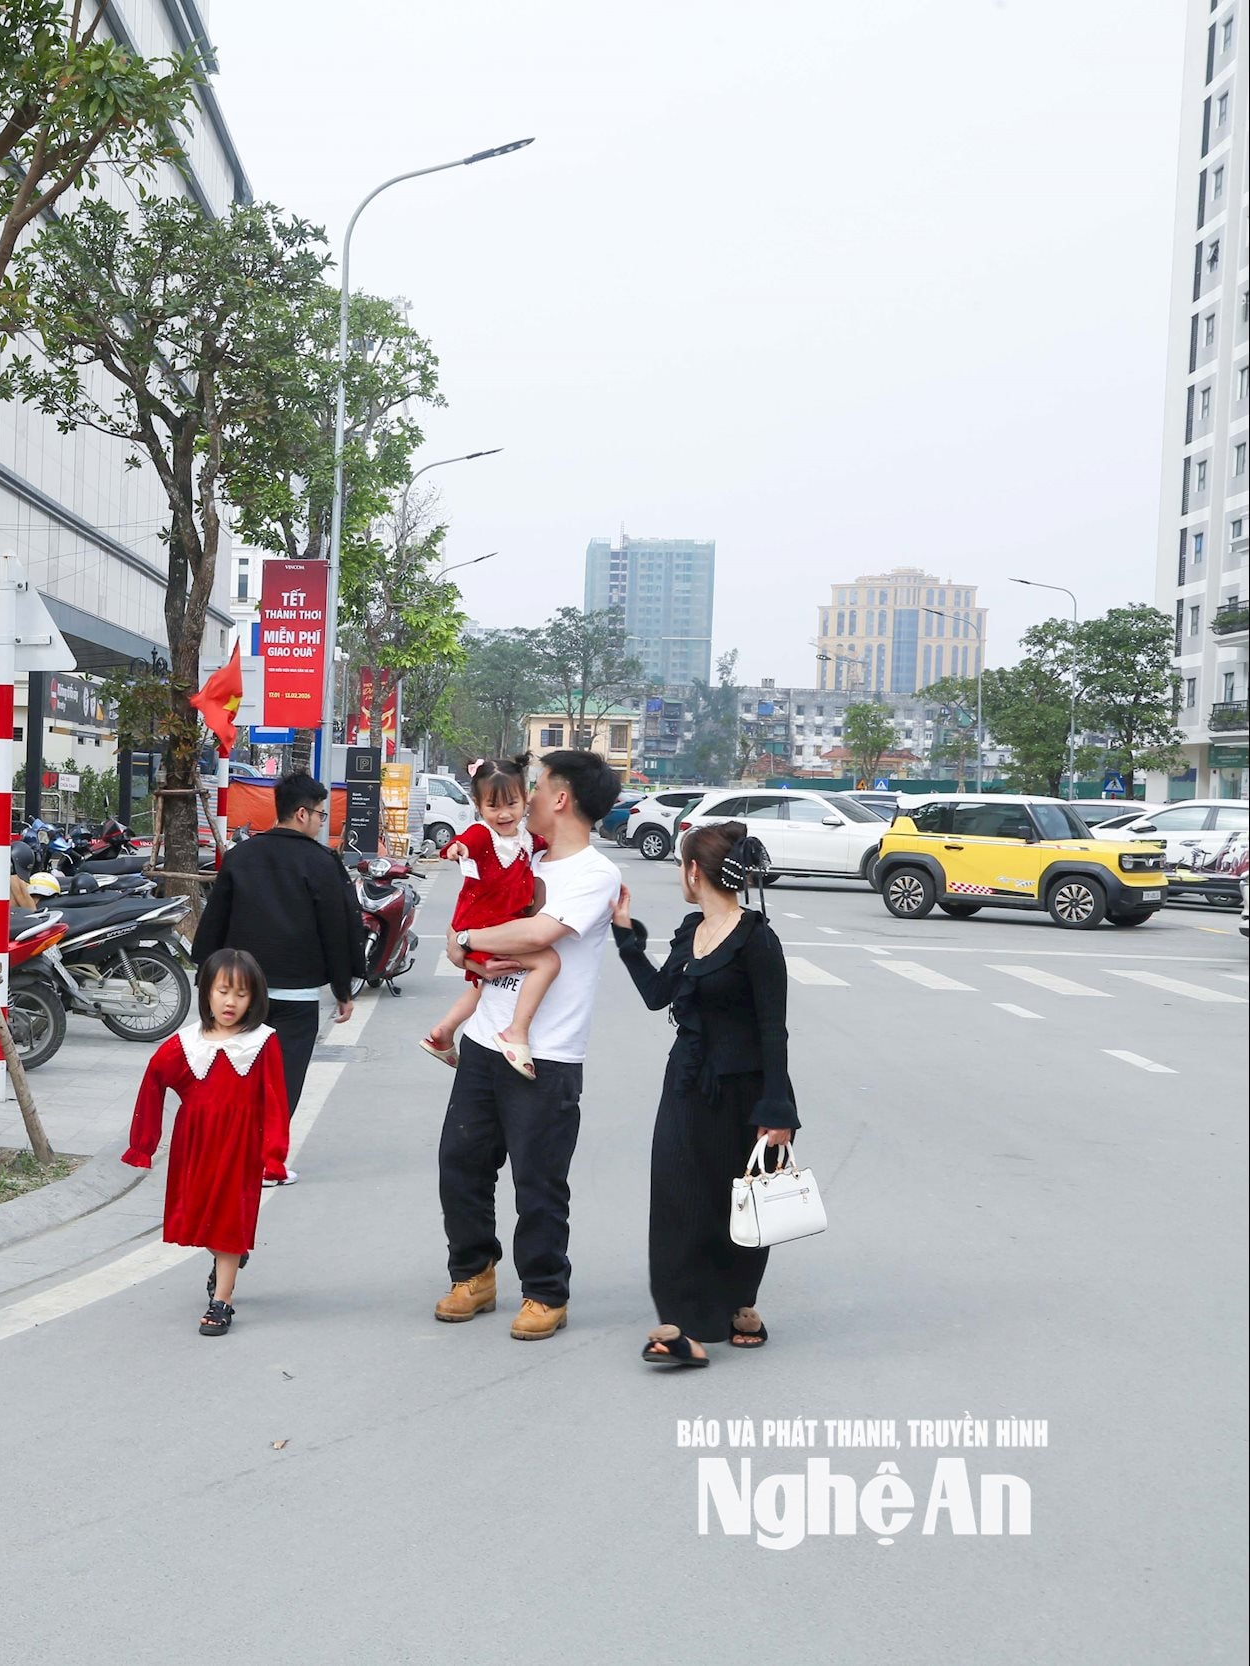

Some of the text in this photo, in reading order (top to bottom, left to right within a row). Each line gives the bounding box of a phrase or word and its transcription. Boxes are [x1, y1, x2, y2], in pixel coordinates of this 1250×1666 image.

[281, 588, 306, 607] TẾT
[299, 609, 322, 620] THƠI
[263, 626, 322, 645] MIỄN PHÍ
[267, 646, 291, 657] GIAO
[501, 976, 520, 991] APE
